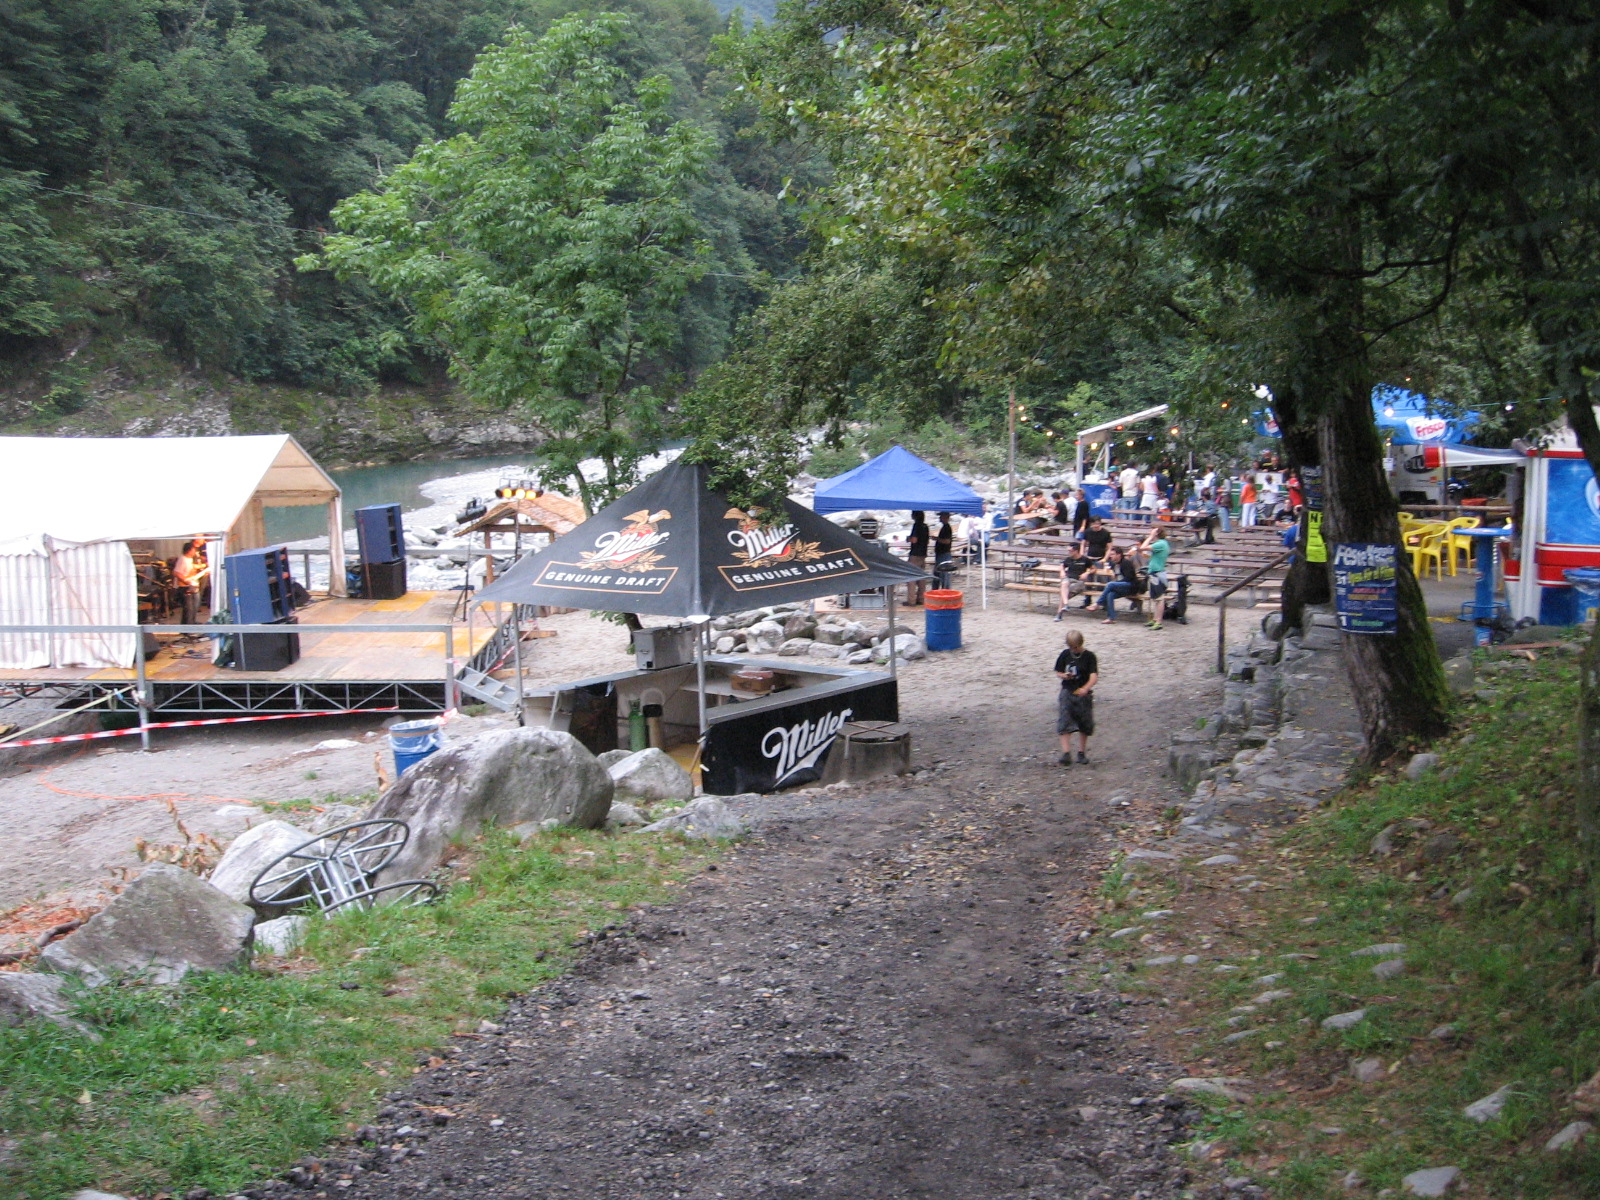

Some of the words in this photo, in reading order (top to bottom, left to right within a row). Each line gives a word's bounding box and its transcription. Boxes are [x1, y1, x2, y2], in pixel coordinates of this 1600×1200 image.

[1415, 422, 1444, 438] Frisco
[593, 531, 670, 561] Miller
[727, 523, 796, 561] Miller
[545, 571, 612, 585] GENUINE
[614, 576, 666, 586] DRAFT
[732, 567, 802, 584] GENUINE
[807, 557, 855, 573] DRAFT
[761, 708, 853, 780] Miller
